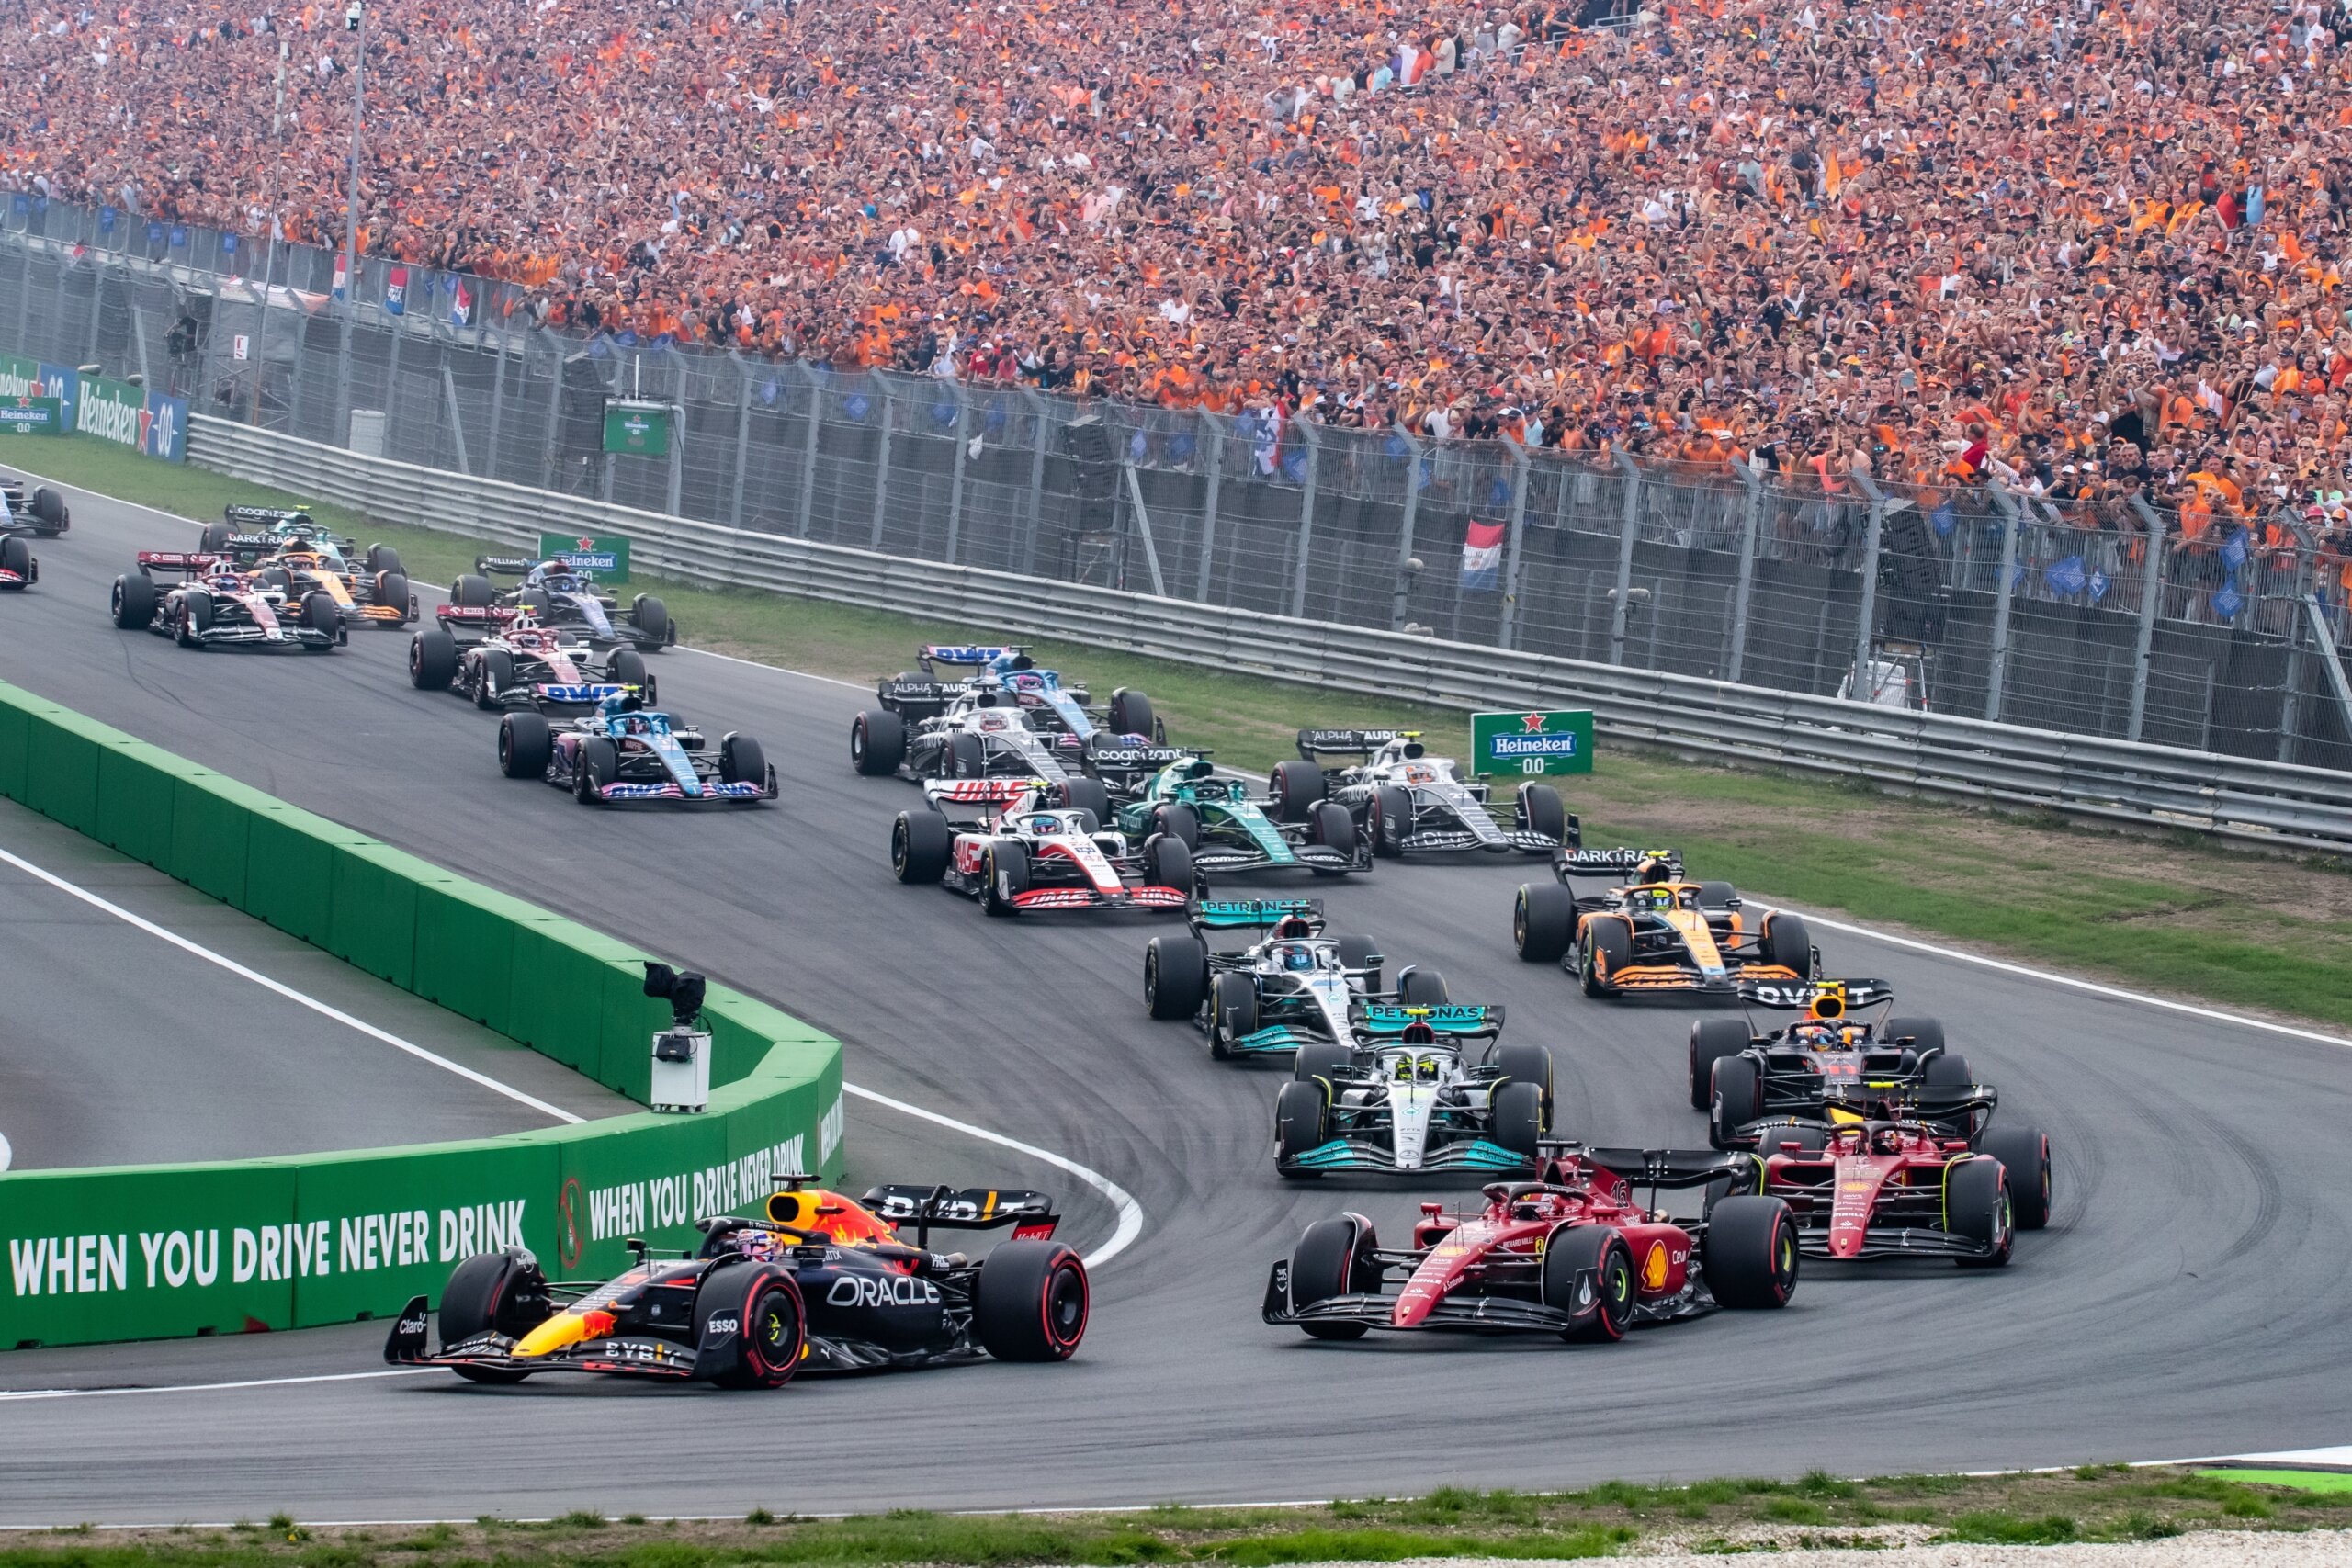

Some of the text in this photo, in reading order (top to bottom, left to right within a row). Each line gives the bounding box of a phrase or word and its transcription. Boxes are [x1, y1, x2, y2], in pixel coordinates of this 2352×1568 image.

[0, 409, 48, 421] Heineken
[77, 380, 137, 446] Heineken
[486, 556, 525, 566] WILLIAMS
[562, 553, 614, 568] eineken
[893, 682, 932, 693] ALPHA
[1314, 730, 1353, 741] ALPHA
[1495, 737, 1572, 753] Heineken
[1097, 748, 1183, 766] cognizant
[1522, 756, 1544, 774] 0.0
[1195, 855, 1248, 863] aramco
[1565, 849, 1672, 863] DARKTRA
[1757, 986, 1873, 1005] BYIT
[1372, 1007, 1479, 1019] PETONAS
[589, 1132, 805, 1242] WHEN YOU DRIVE NEVER DRINK
[1611, 1179, 1631, 1209] 16
[9, 1200, 526, 1297] WHEN YOU DRIVE NEVER DRINK
[1502, 1235, 1534, 1248] RICHARD MILLE
[827, 1276, 941, 1307] ORACLE
[399, 1317, 424, 1334] Claro
[708, 1319, 739, 1334] ESSO
[605, 1341, 682, 1366] BYBIT
